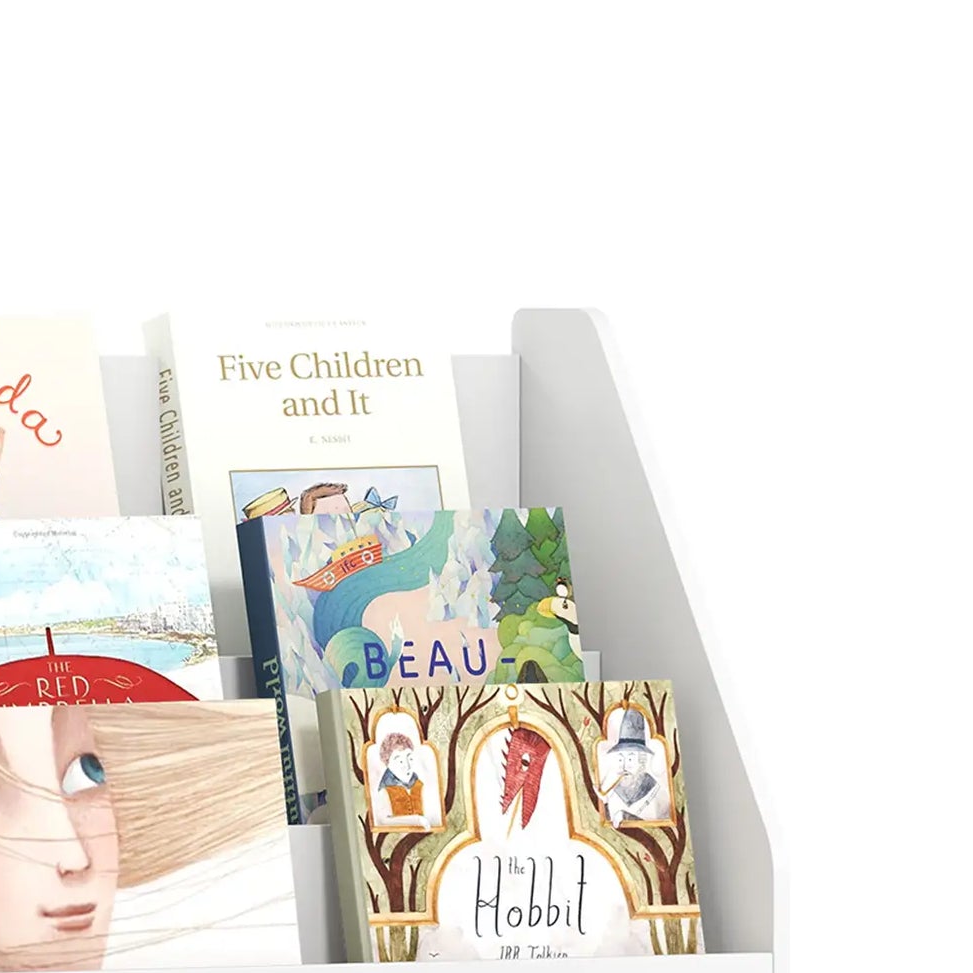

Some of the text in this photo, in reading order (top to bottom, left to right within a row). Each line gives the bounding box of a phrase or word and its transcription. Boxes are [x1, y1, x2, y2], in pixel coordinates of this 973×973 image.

[216, 350, 425, 382] Five Children
[158, 368, 174, 405] Five
[281, 388, 373, 417] and It
[159, 409, 183, 484] Children
[47, 661, 73, 674] THE
[35, 675, 91, 699] RED
[508, 855, 526, 875] the
[472, 853, 588, 938] Hobbit
